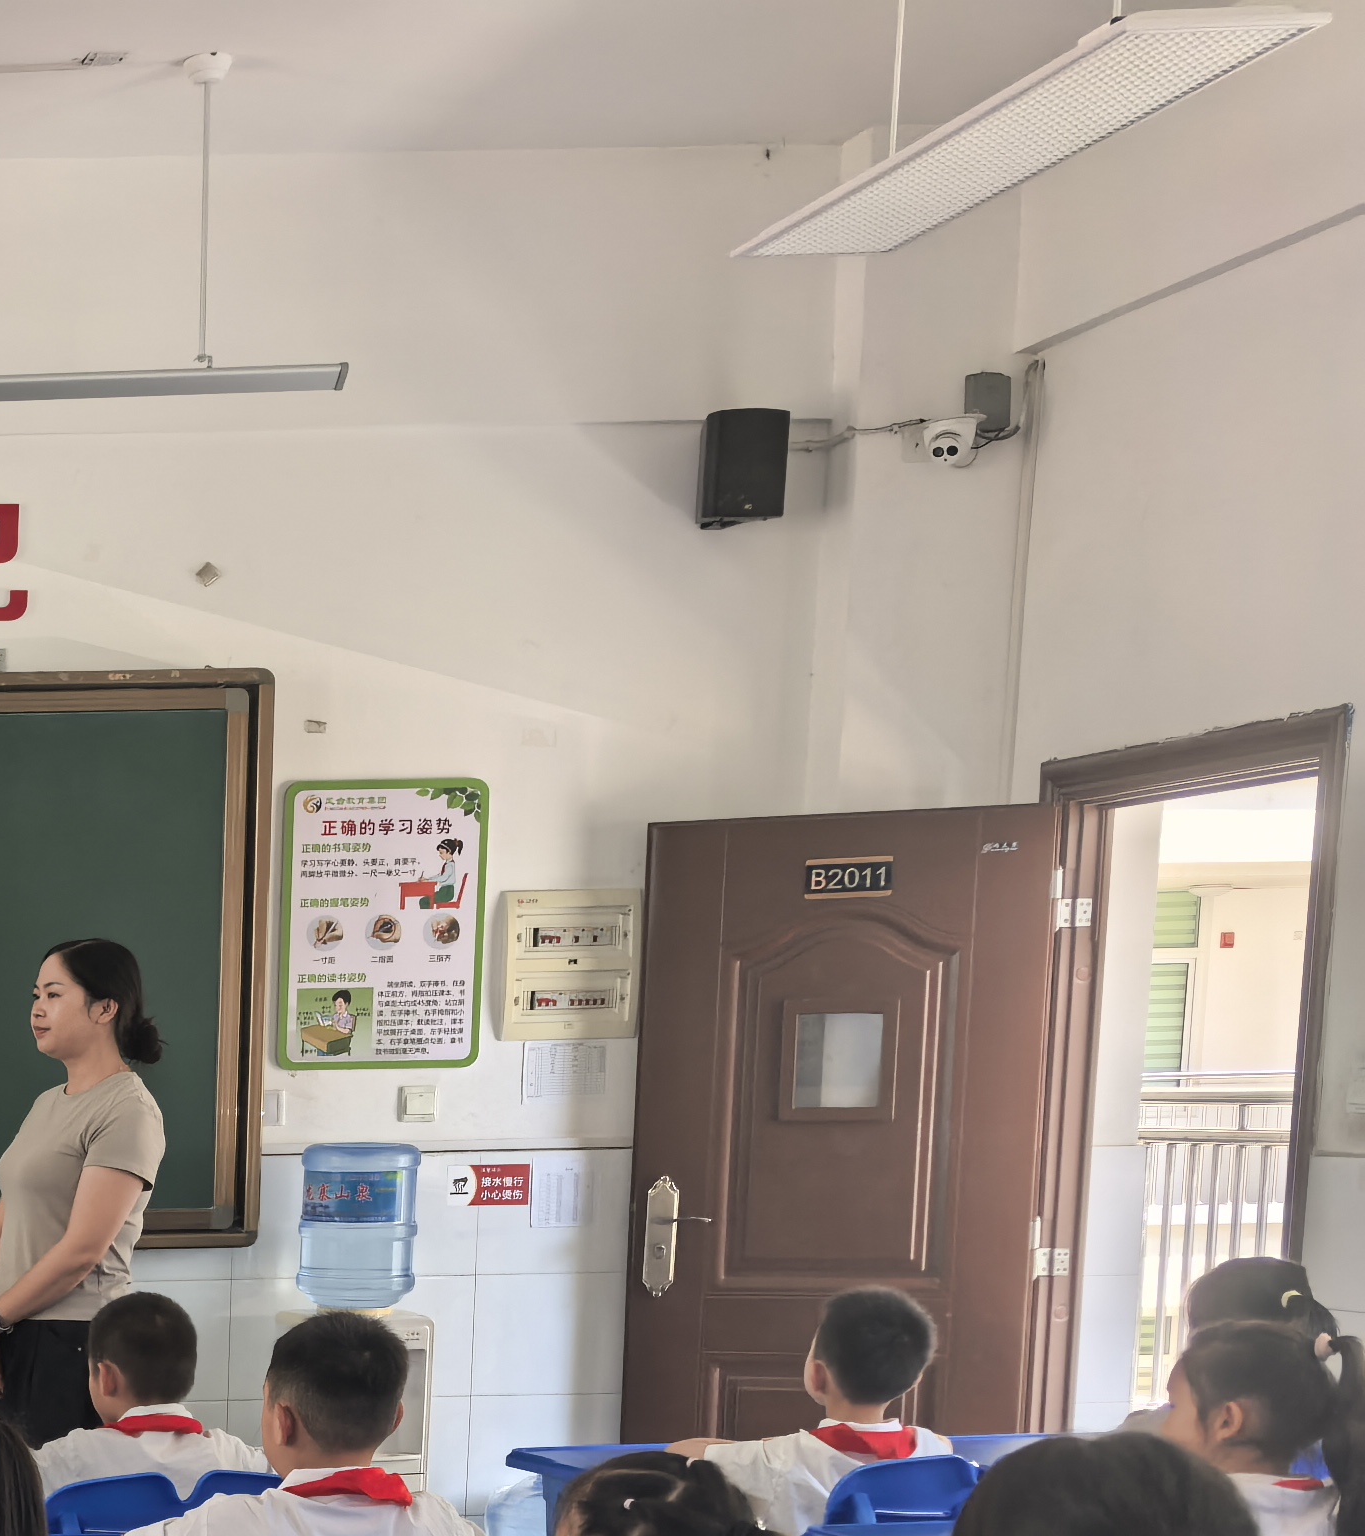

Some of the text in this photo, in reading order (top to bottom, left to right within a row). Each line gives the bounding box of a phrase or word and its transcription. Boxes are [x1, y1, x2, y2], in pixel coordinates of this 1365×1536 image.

[321, 816, 453, 837] 正确的学习姿势
[302, 842, 372, 853] 正确的书写姿势
[810, 866, 887, 891] B2011
[300, 897, 370, 908] 正确的握笔姿势
[312, 956, 336, 964] 一寸距
[297, 973, 367, 983] 正确的读书姿势
[481, 1176, 524, 1188] 接水慢行
[480, 1189, 524, 1200] 小心烫伤
